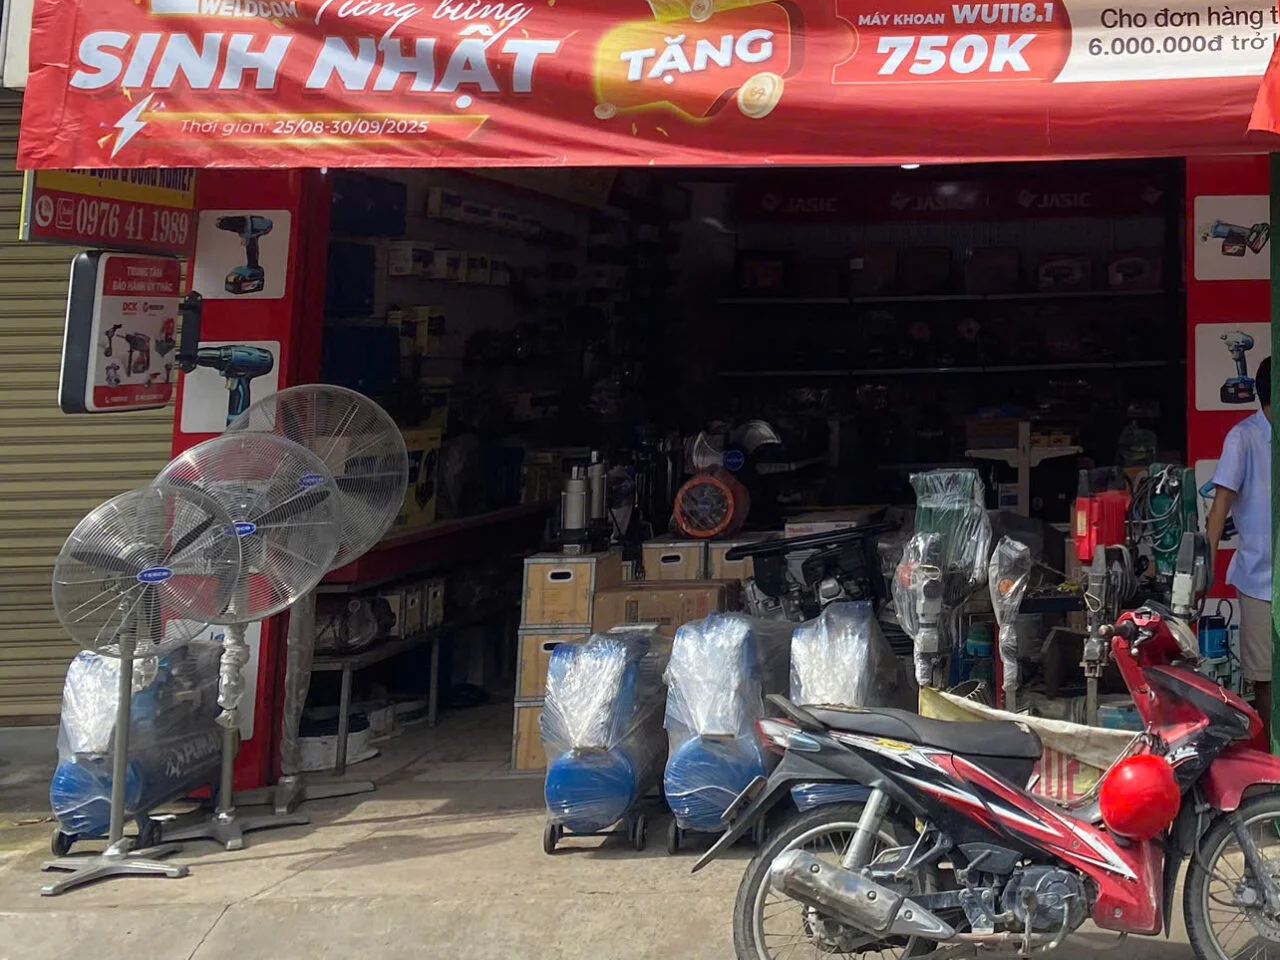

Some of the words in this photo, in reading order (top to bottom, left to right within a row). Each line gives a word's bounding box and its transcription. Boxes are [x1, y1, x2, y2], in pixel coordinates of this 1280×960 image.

[858, 11, 890, 27] MÁY
[893, 12, 945, 26] KHOAN
[952, 2, 1054, 25] WU118.1
[1100, 7, 1147, 30] Cho
[1153, 6, 1203, 28] đơn
[1207, 6, 1263, 30] hàng
[619, 28, 776, 84] TẶNG
[877, 33, 1037, 76] 750K
[1088, 33, 1224, 57] 6.000.000đ
[1231, 31, 1269, 51] trở
[70, 31, 293, 91] SINH
[306, 24, 561, 109] NHẬT
[180, 117, 218, 135] Thời
[272, 118, 430, 135] 25/08-30/09/2025
[76, 198, 120, 239] 0976
[124, 205, 144, 240] 41
[152, 209, 189, 245] 1989
